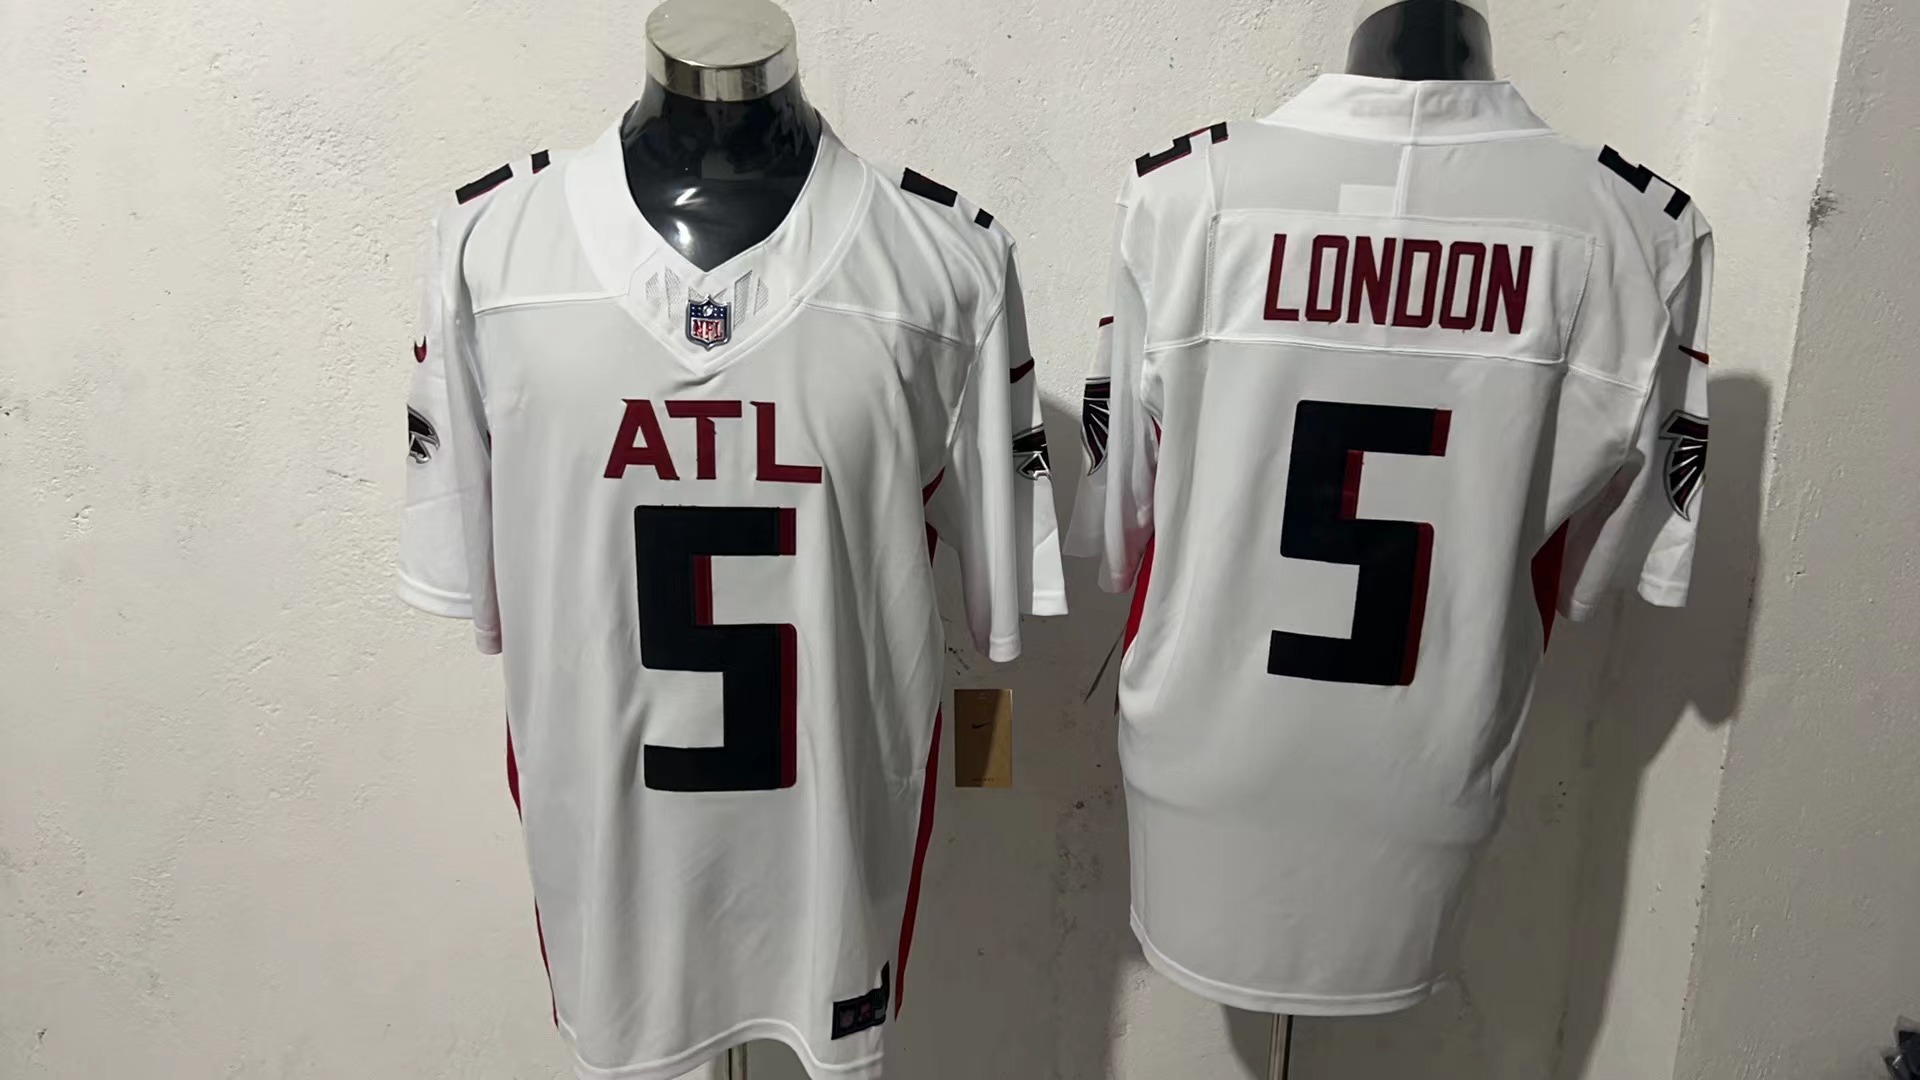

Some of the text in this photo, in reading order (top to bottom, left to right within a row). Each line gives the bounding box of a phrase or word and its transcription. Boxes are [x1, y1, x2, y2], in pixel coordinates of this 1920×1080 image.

[692, 319, 724, 341] NFL
[1263, 233, 1534, 334] LONDON
[603, 398, 823, 484] ATL
[1266, 399, 1452, 686] 5
[633, 504, 798, 793] 5
